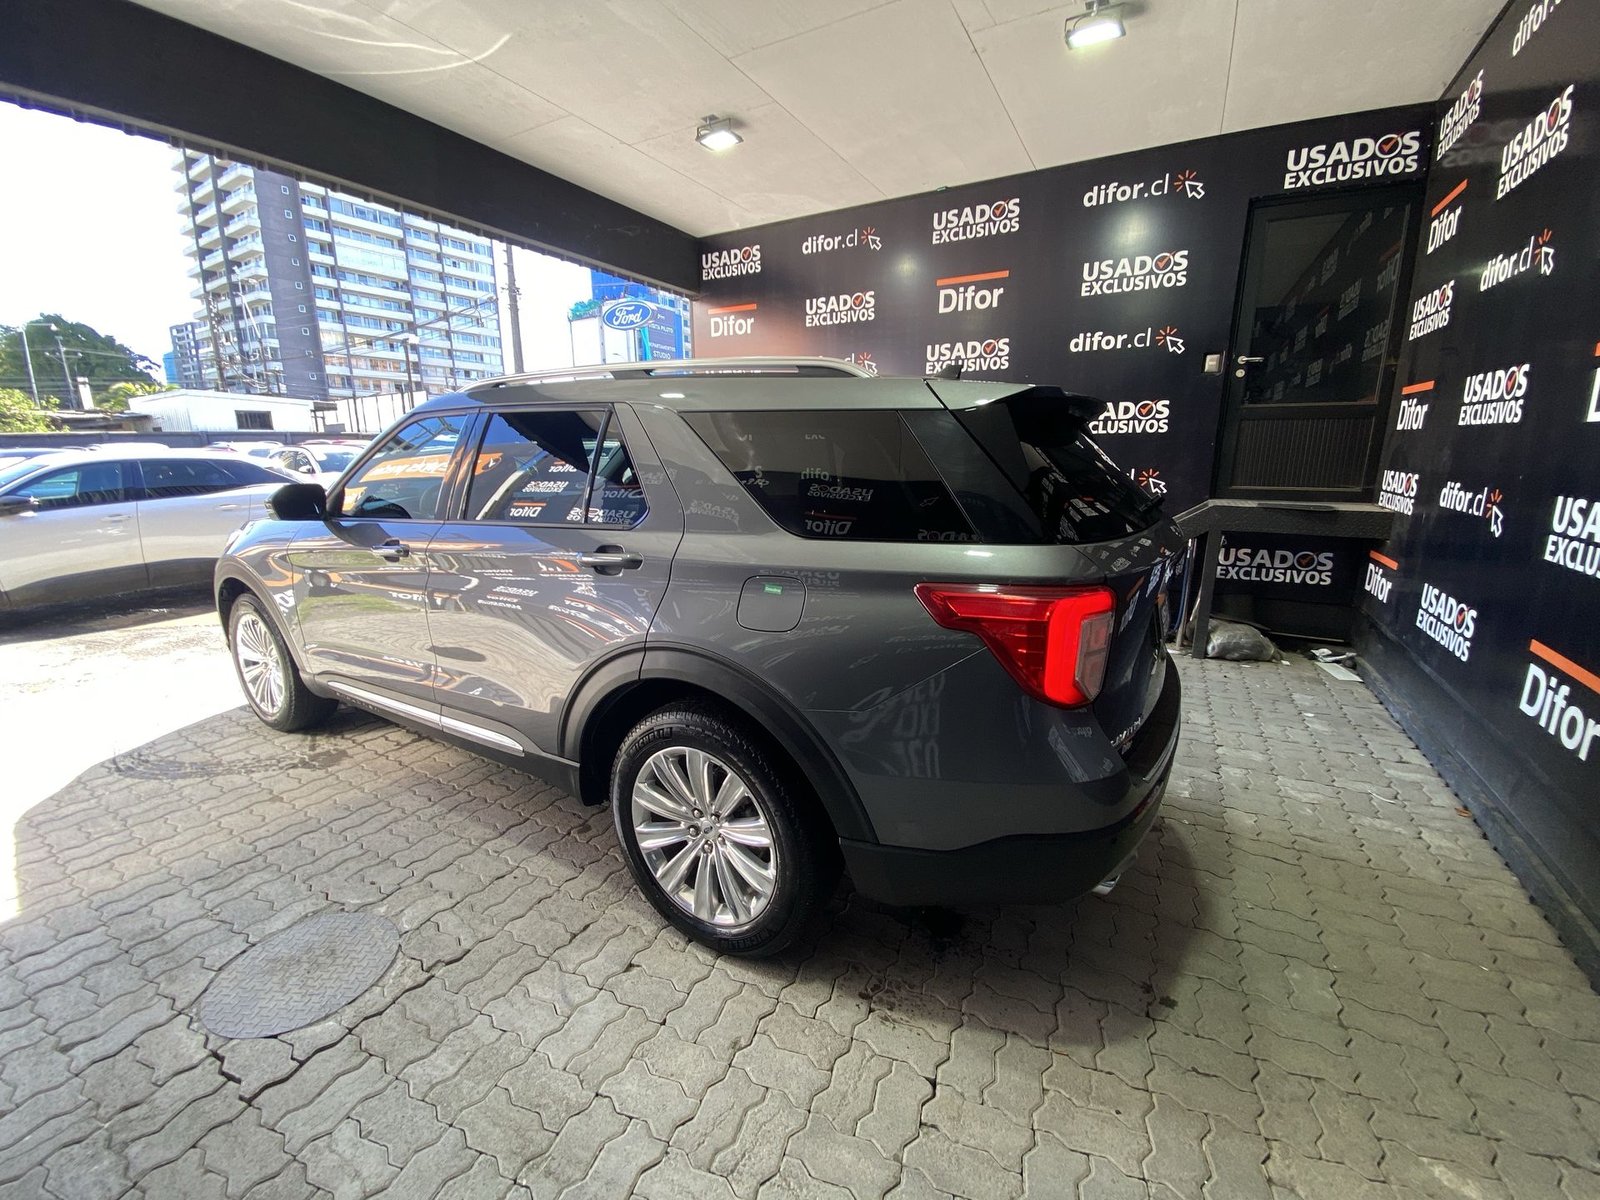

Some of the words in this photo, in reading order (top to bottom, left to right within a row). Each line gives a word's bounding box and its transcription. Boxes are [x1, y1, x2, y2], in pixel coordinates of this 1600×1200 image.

[1440, 69, 1484, 141] USADOS
[1437, 98, 1480, 161] EXCLUSIVOS
[1501, 84, 1575, 174] USADOS
[1286, 130, 1421, 172] USADOS
[1496, 123, 1570, 201] EXCLUSIVOS
[1283, 154, 1418, 190] EXCLUSIVOS
[1083, 173, 1171, 208] difor.cl
[932, 198, 1020, 231] USADOS
[1427, 206, 1462, 255] Difor
[802, 229, 858, 255] difor.cl
[932, 218, 1020, 244] EXCLUSIVOS
[702, 246, 761, 268] USADOS
[702, 261, 761, 280] EXCLUSIVOS
[1082, 250, 1189, 282] USADOS
[1480, 236, 1535, 292] difor.cl
[938, 285, 1004, 314] Difor
[1080, 271, 1187, 297] EXCLUSIVOS
[613, 305, 643, 326] Ford
[805, 291, 875, 315] USADOS
[805, 308, 875, 327] EXCLUSIVOS
[1413, 283, 1453, 322] USADOS
[710, 314, 754, 338] Difor
[1069, 327, 1152, 353] difor.cl
[1409, 307, 1450, 341] EXCLUSIVOS
[926, 338, 1010, 362] USADOS
[1464, 363, 1530, 403] USADOS
[1098, 399, 1170, 420] ADOS
[1396, 398, 1428, 430] Difor
[1458, 399, 1524, 426] EXCLUSIVOS
[1088, 419, 1169, 434] CLUSIVOS
[1382, 469, 1419, 497] USADOS
[1439, 481, 1488, 517] difor.cl
[1378, 491, 1414, 516] EXCLUSIVOS
[1217, 548, 1334, 571] USADOS
[1216, 566, 1332, 586] EXCLUSIVOS
[1365, 562, 1393, 604] Difor
[1421, 583, 1477, 639] USADOS
[1416, 608, 1471, 663] EXCLUSIVOS
[1519, 663, 1600, 762] Difor
